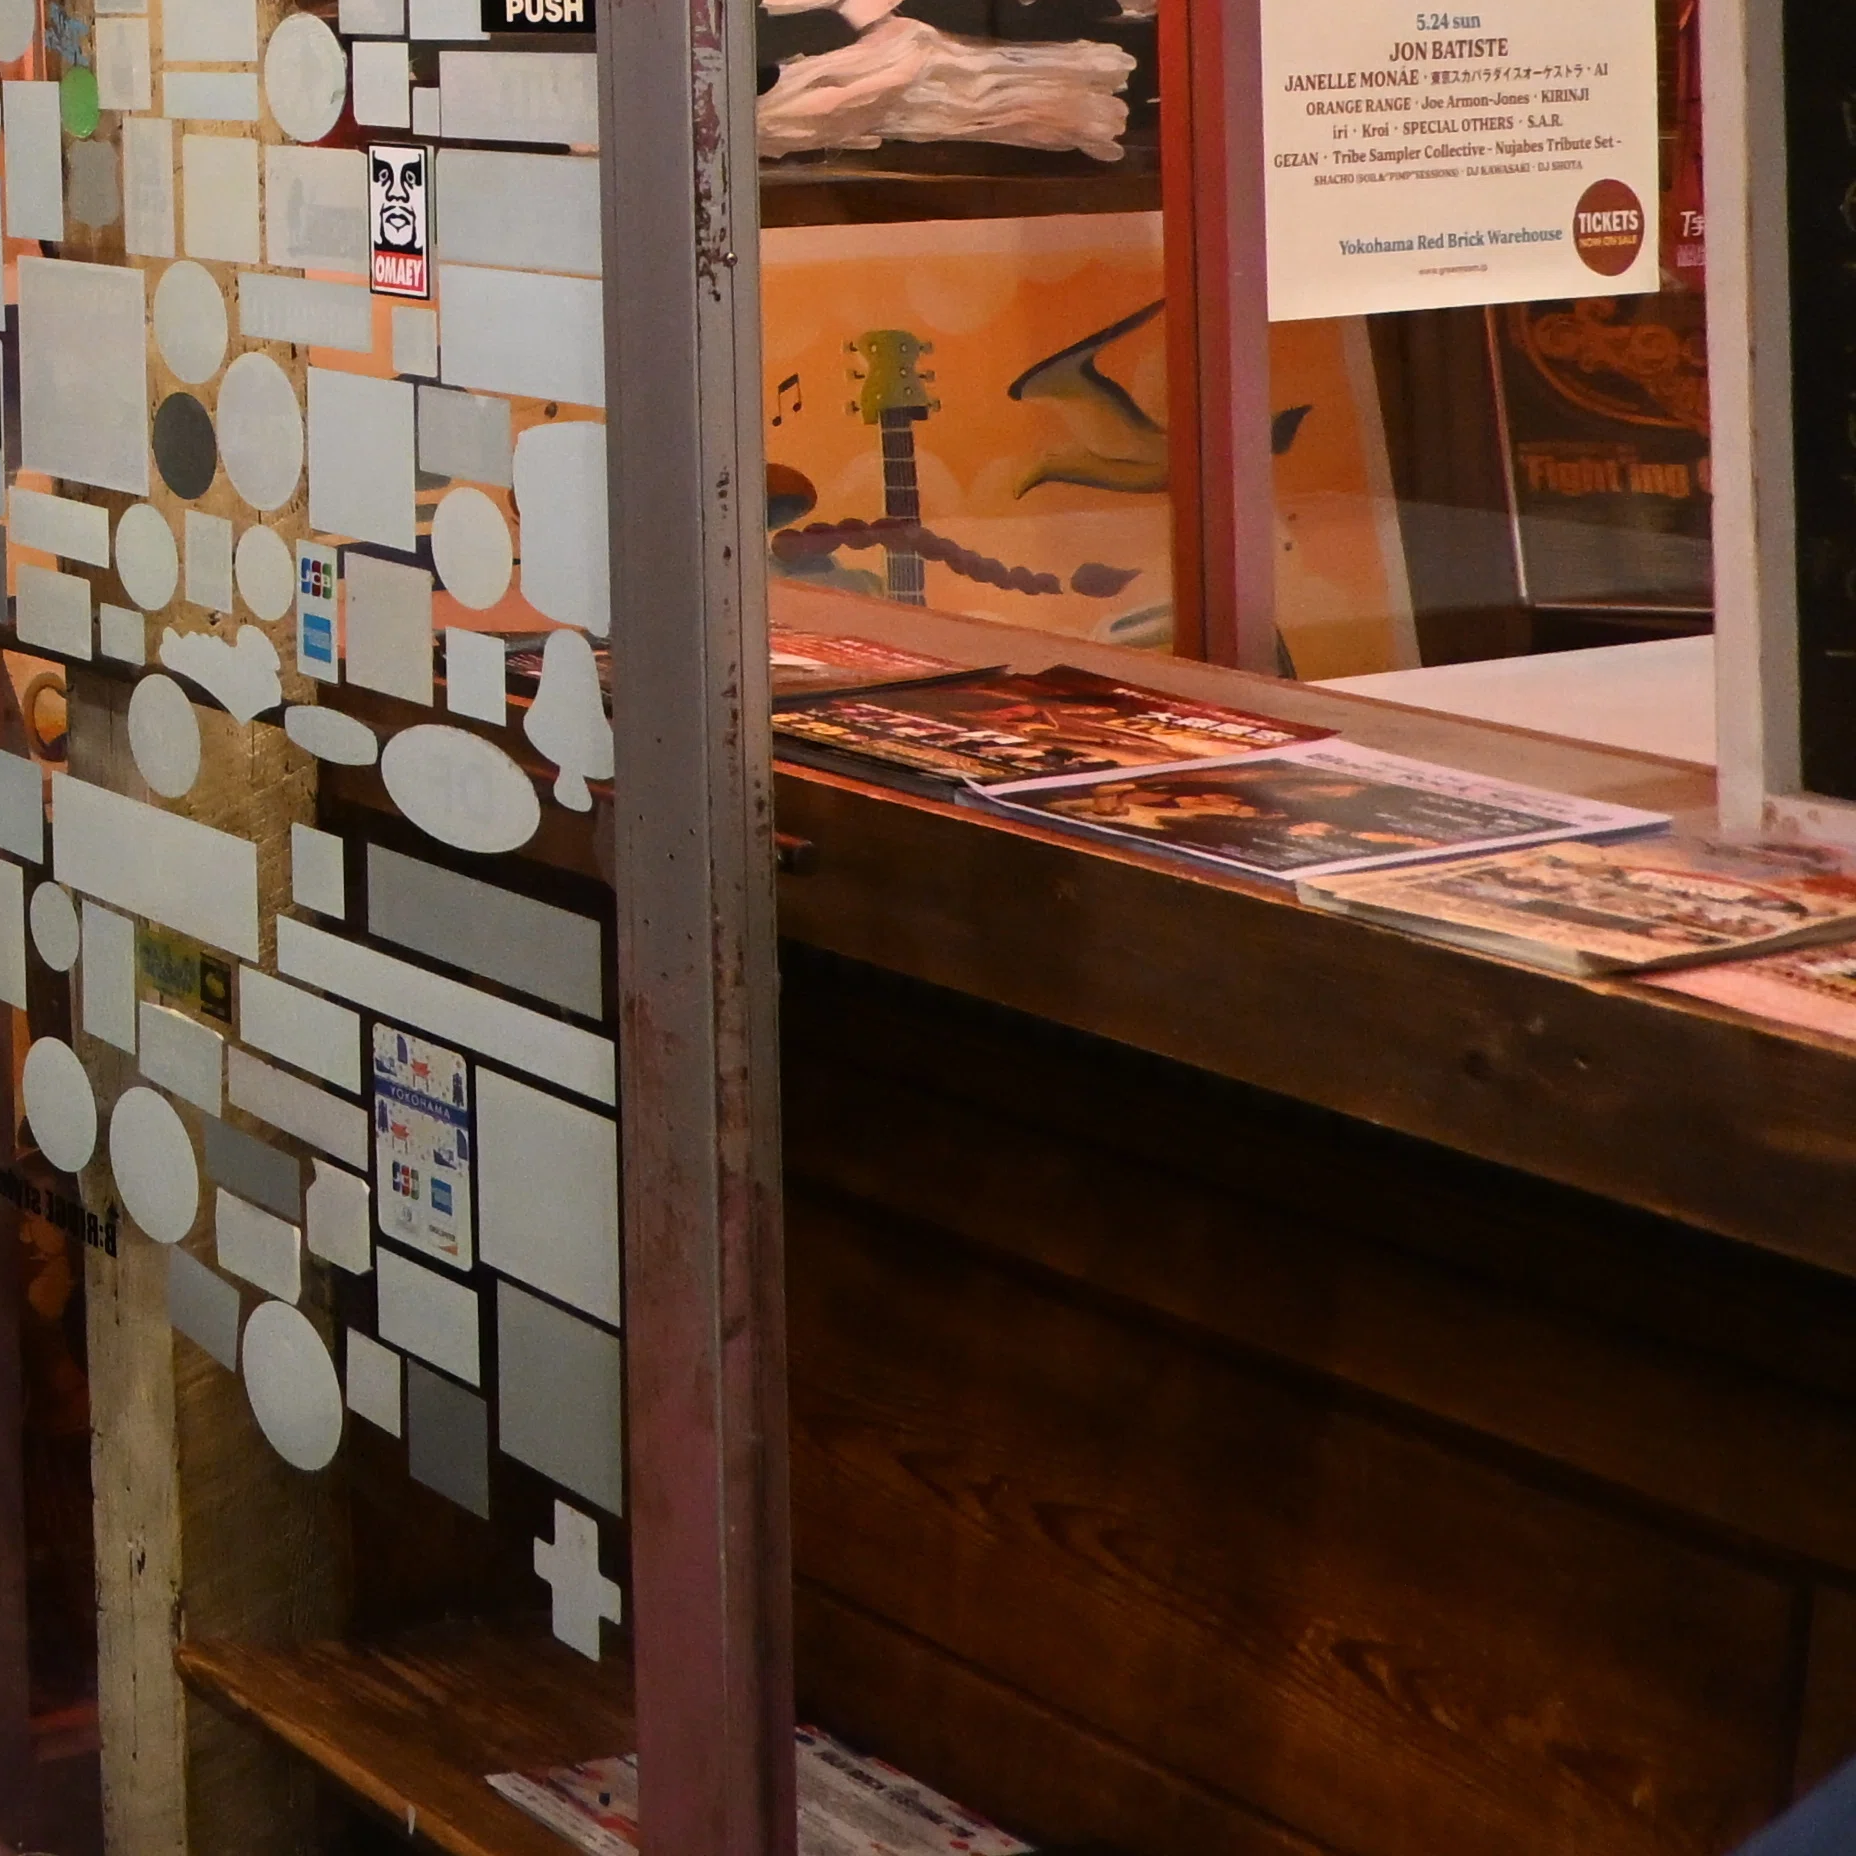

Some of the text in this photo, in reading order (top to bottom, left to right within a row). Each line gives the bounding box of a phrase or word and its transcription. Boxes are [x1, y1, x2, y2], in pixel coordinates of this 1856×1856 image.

[1416, 13, 1481, 31] 5.24 sun
[1389, 38, 1509, 62] JON BATISTE
[1284, 72, 1357, 93] JANELLE
[1594, 63, 1609, 76] AI
[1306, 88, 1590, 116] ORANGE RANGE Joe Armon-Jones KIRINJI
[1332, 124, 1348, 139] iri
[1362, 122, 1390, 138] Kroi
[1402, 119, 1460, 136] SPECIAL
[1461, 116, 1514, 133] OTHERS
[1274, 135, 1614, 168] GEZAN Tribe Sampler Collective Nujabes Tribute Set
[1578, 208, 1639, 234] TICKETS
[1339, 227, 1563, 256] Yokohama Red Brick Warehouse
[373, 258, 424, 289] OMAEY
[390, 1086, 451, 1120] YOKOHAMA
